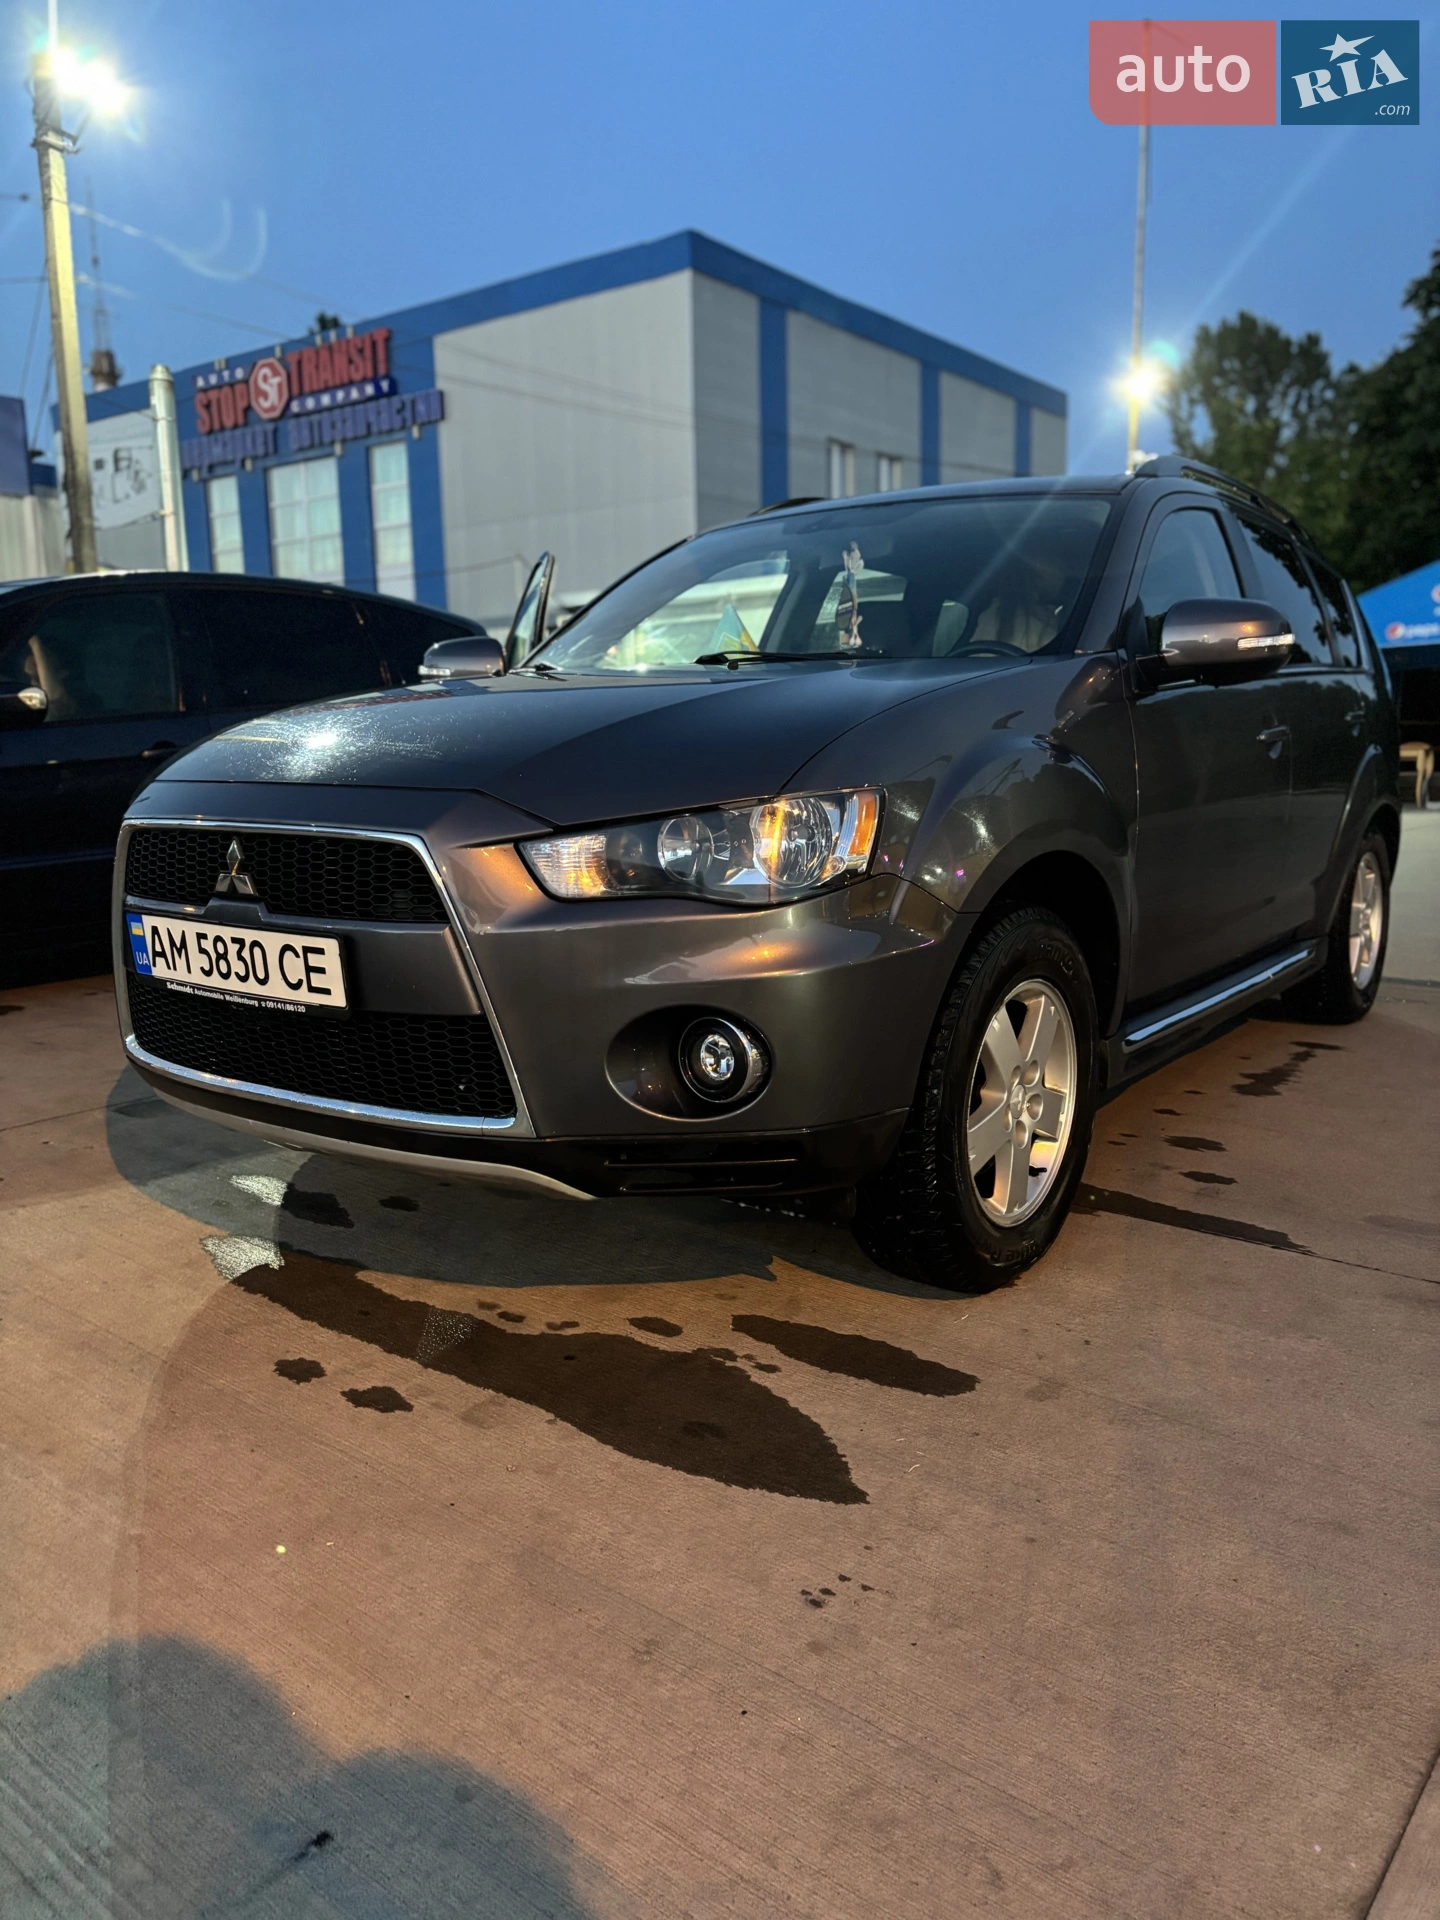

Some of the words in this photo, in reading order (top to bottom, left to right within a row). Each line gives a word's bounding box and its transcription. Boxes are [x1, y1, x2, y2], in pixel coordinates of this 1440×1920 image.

[194, 381, 249, 434] STOP
[285, 328, 391, 396] TRANSIT
[196, 366, 245, 388] AUTO
[290, 379, 391, 413] COMPANY
[136, 951, 150, 966] UA
[150, 925, 192, 975] AM
[196, 932, 270, 986] 5830
[278, 943, 332, 996] CE
[166, 981, 194, 995] Schmidt
[194, 988, 224, 1001] Automobile
